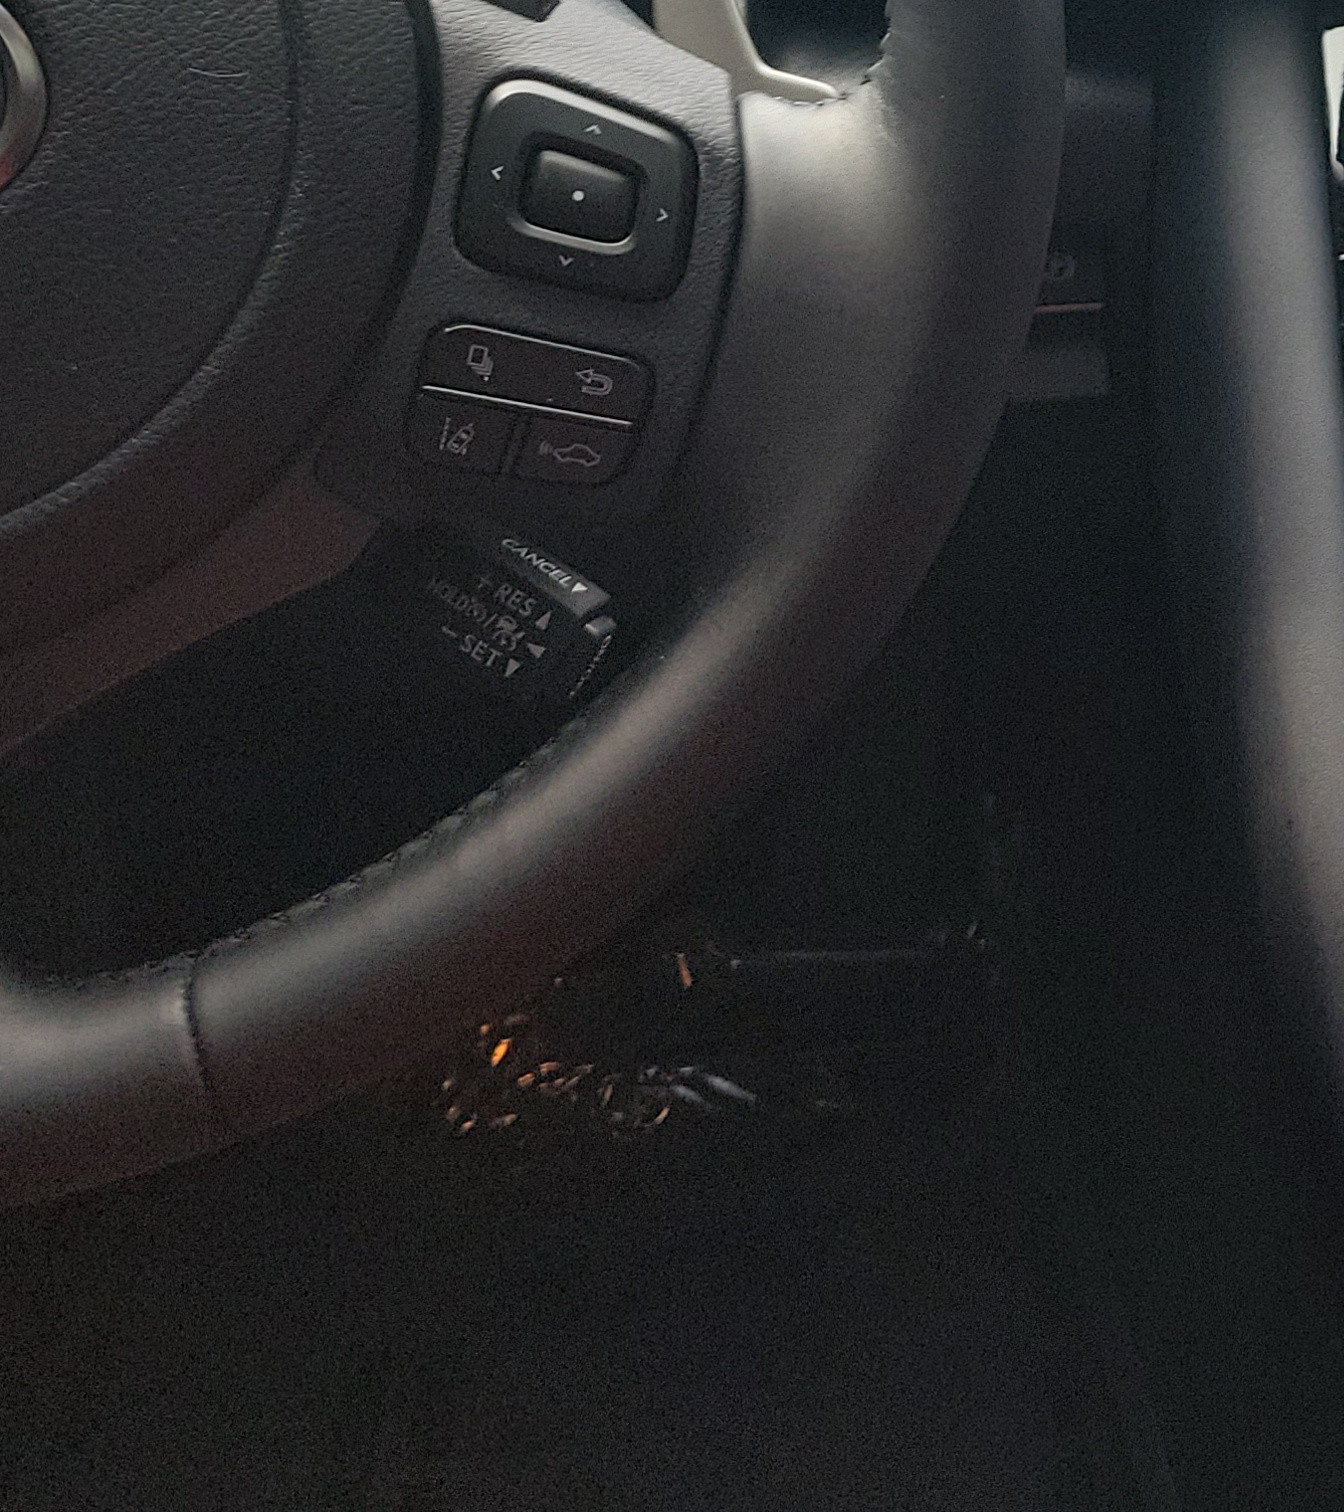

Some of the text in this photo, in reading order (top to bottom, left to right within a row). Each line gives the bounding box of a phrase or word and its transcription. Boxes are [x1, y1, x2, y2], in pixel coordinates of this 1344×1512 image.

[500, 537, 574, 590] CANCEL
[494, 582, 538, 617] RES
[459, 633, 505, 668] SET
